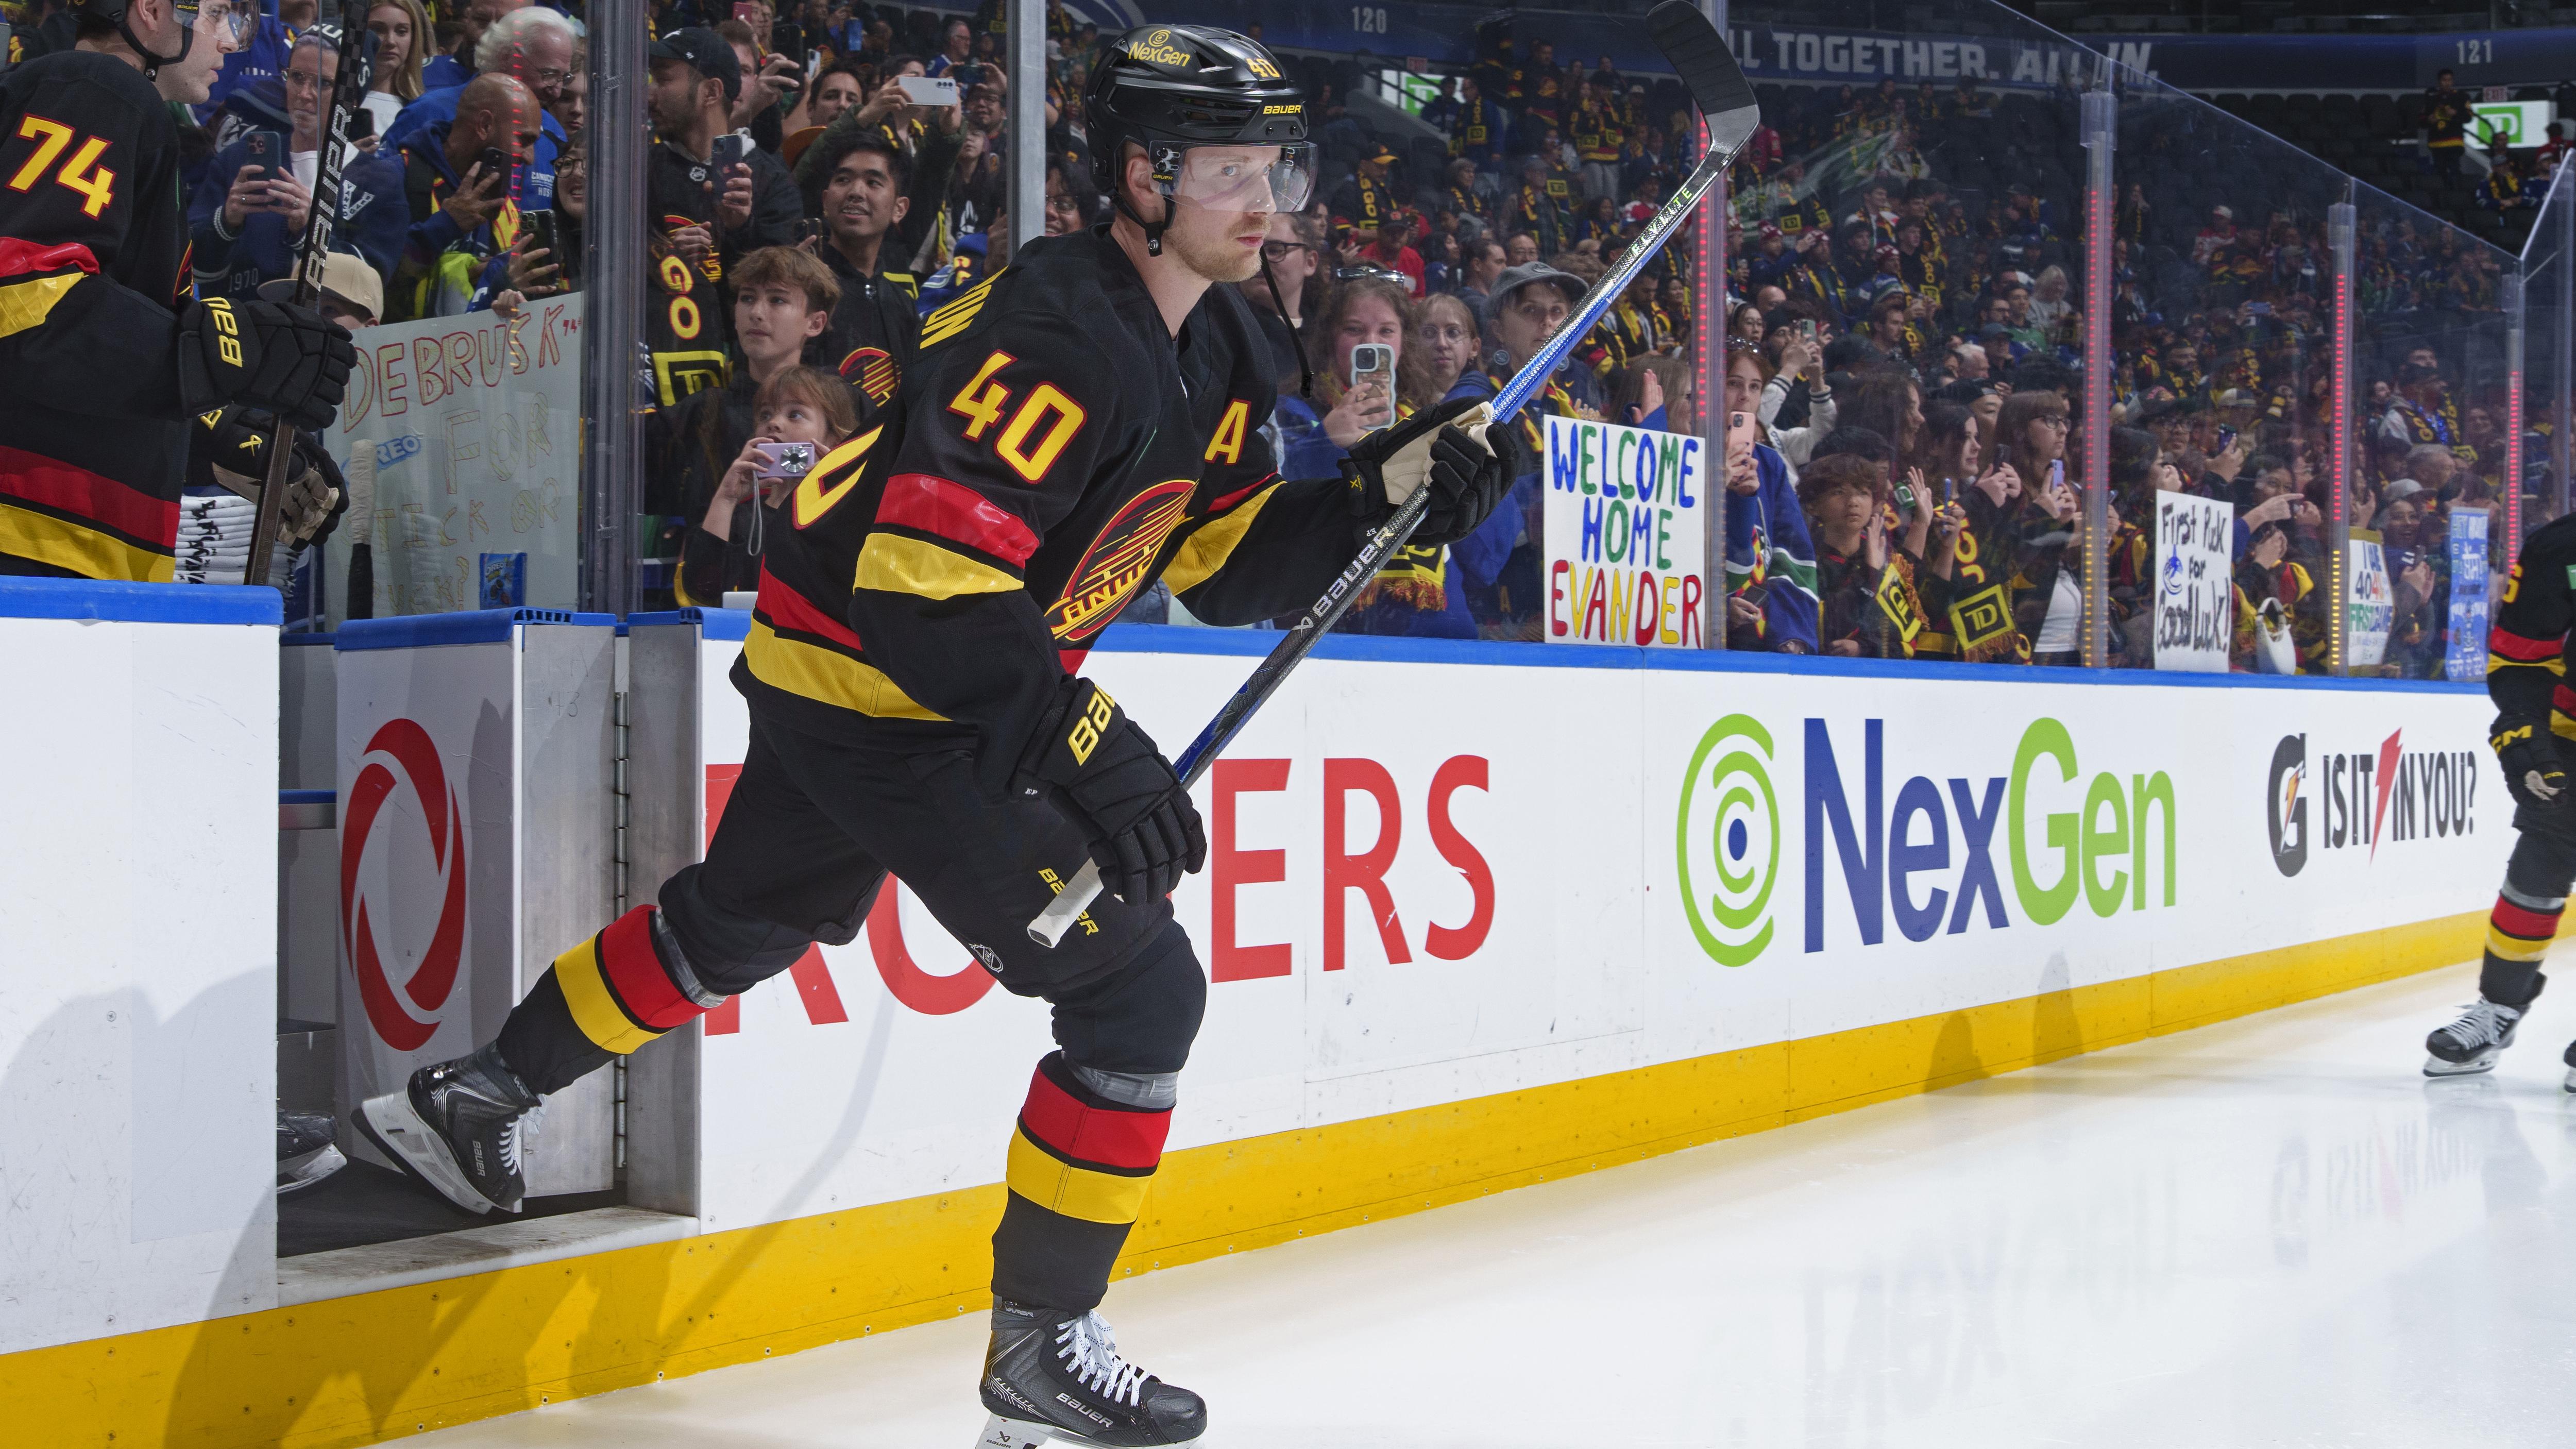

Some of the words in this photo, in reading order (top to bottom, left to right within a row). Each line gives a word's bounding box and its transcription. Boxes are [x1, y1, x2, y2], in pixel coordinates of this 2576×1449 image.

[1352, 7, 1387, 34] 120
[1128, 41, 1191, 67] NexGen
[1245, 57, 1281, 78] 40
[1727, 29, 1761, 69] LL
[1772, 32, 1999, 80] TOGETHER.
[2456, 39, 2492, 64] 121
[1263, 105, 1302, 114] BAUER
[5, 112, 116, 221] 74
[1153, 173, 1174, 181] BAUER
[228, 267, 259, 293] 1970
[199, 297, 243, 367] BAU
[342, 304, 565, 434] DEBRUSK
[945, 348, 1088, 484] 40
[1205, 398, 1251, 465] A
[374, 435, 419, 465] REO
[442, 392, 553, 495] FOR
[1551, 420, 1699, 508] WELCOME
[512, 477, 561, 533] OR
[1366, 527, 1377, 537] EP
[1581, 497, 1673, 570] HOME
[1312, 527, 1394, 618] BAUER
[1551, 559, 1703, 649] EVANDER
[1964, 603, 1998, 631] TD
[1279, 658, 1299, 681] TWITCH
[1300, 637, 1316, 657] TAPER
[2267, 733, 2308, 878] G
[2323, 753, 2348, 849] IS
[2351, 754, 2374, 846] IT
[2392, 753, 2416, 841] IN
[2418, 750, 2477, 838] YOU?
[1804, 717, 2176, 954] NexGen
[472, 1140, 486, 1177] BAUER
[1056, 1392, 1114, 1428] BAUER
[986, 1439, 1012, 1449] BAUER
